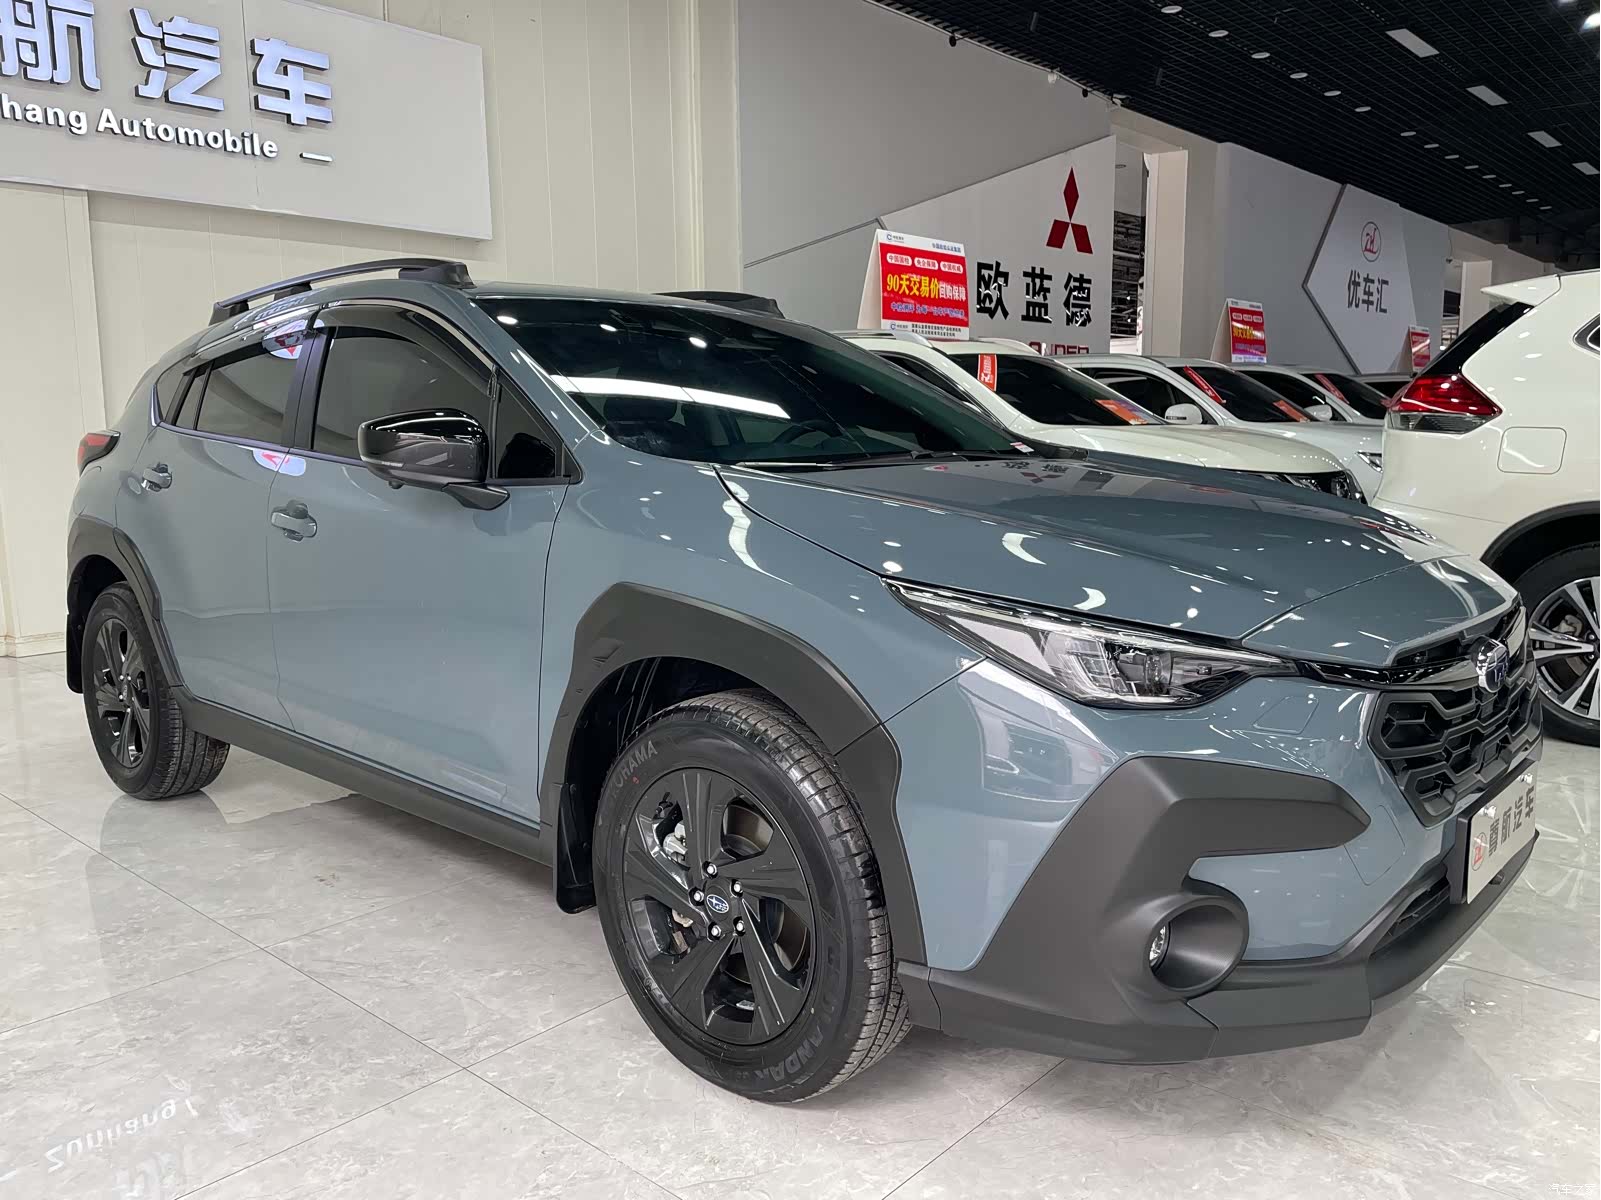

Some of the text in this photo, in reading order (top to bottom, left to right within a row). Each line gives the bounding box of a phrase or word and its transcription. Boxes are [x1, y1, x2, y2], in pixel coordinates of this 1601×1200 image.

[97, 108, 279, 159] Automobile
[976, 260, 1093, 328] 欧蓝德
[1347, 269, 1390, 314] 优车汇
